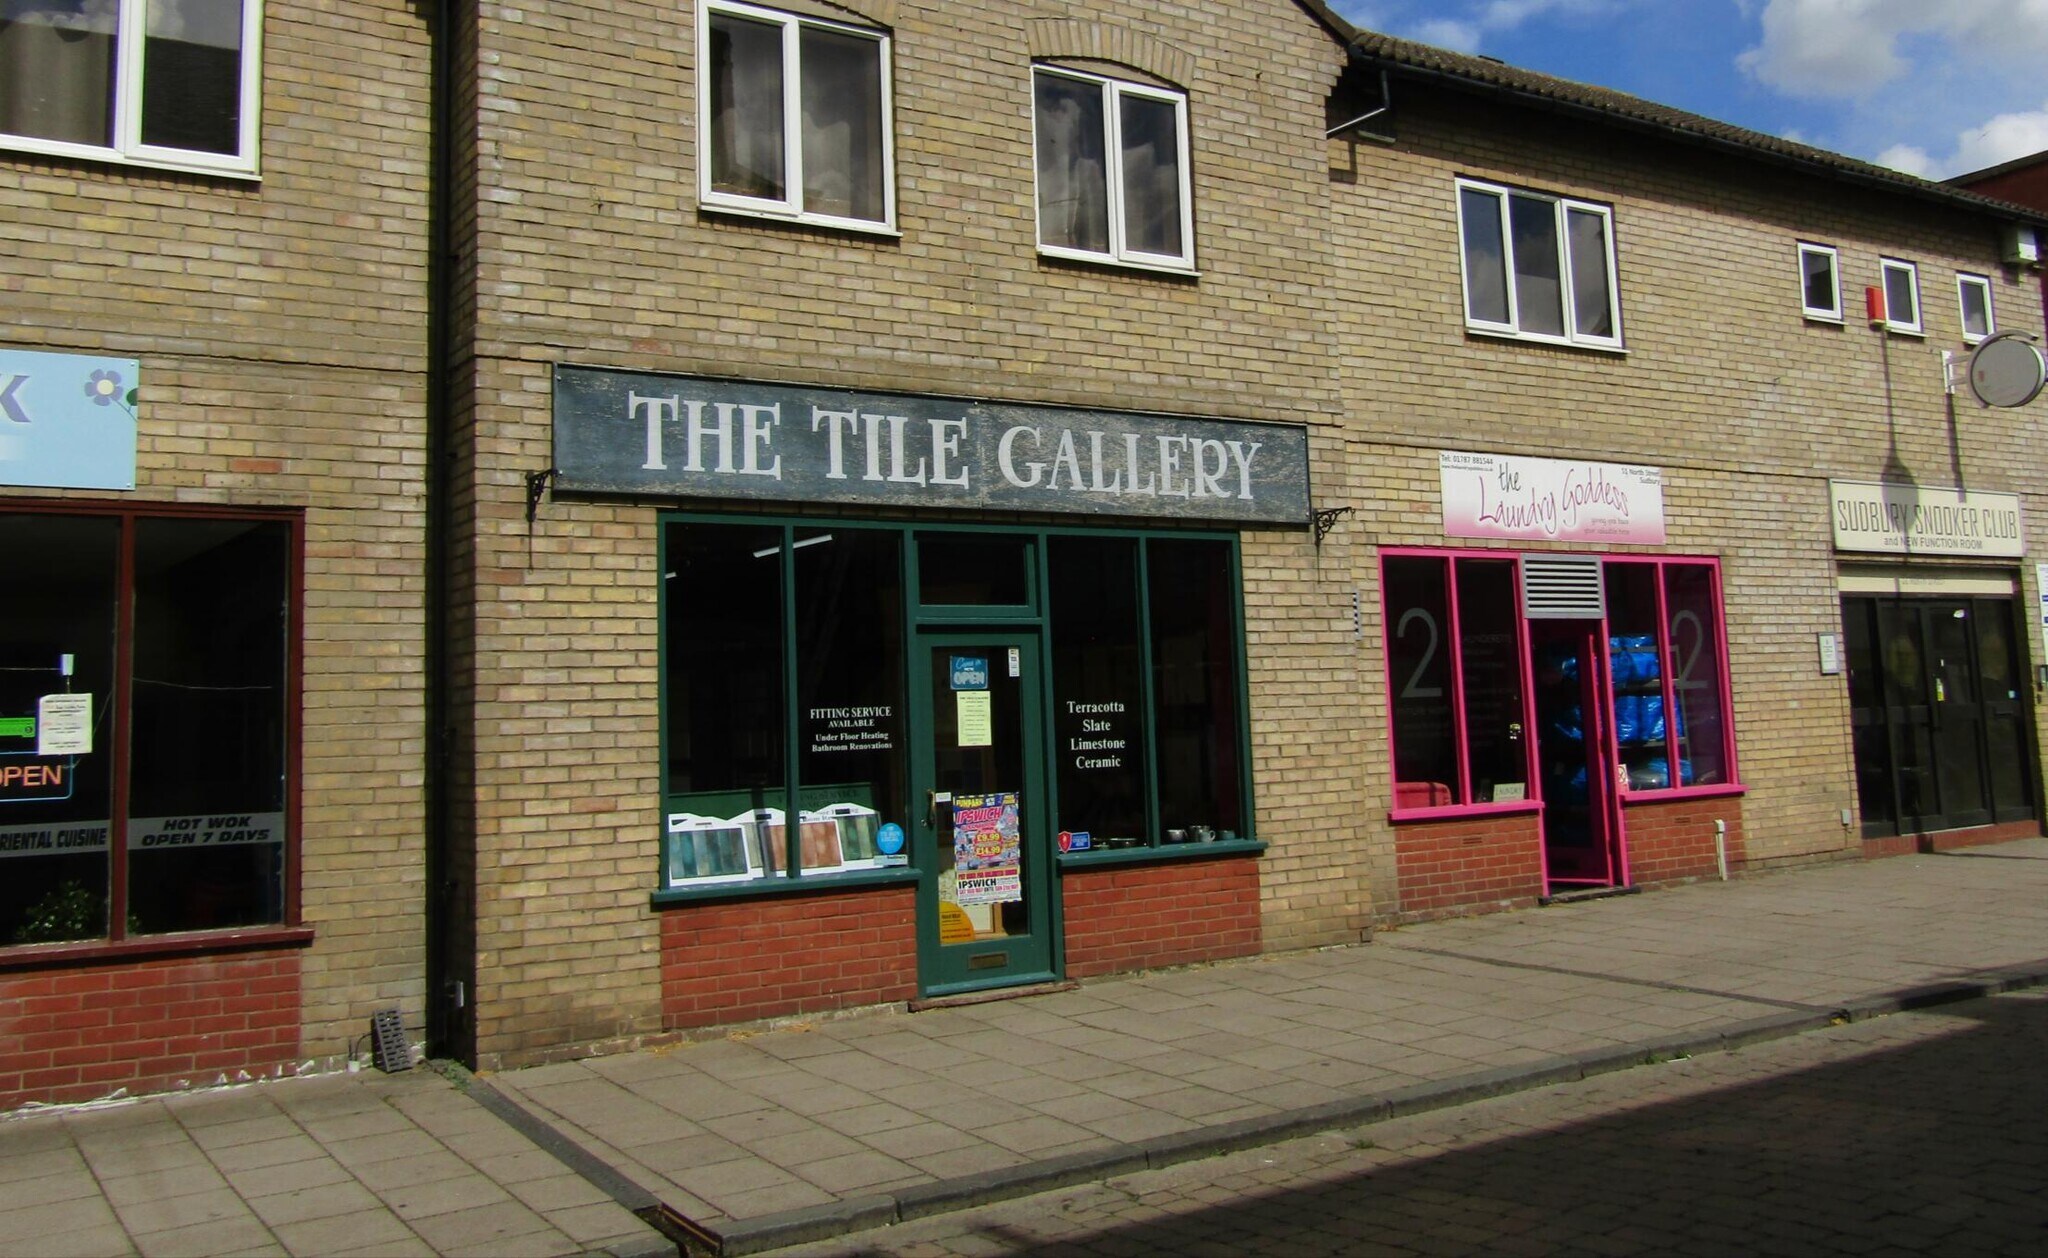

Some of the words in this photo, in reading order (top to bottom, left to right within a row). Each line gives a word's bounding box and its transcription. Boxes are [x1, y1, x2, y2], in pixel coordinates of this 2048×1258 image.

[628, 390, 781, 480] THE
[811, 405, 970, 489] TILE
[998, 425, 1262, 500] GALLERY
[1498, 461, 1522, 493] the
[1478, 474, 1557, 535] Laundry
[1562, 467, 1629, 528] Goddess
[1837, 500, 1907, 533] SUDBURY
[1914, 504, 1979, 537] SNOOKER
[1983, 509, 2018, 539] CLUB
[1884, 536, 1899, 547] and
[1900, 537, 1919, 547] NEW
[1920, 537, 1958, 549] FUNCTION
[1960, 538, 1984, 549] ROOM
[1397, 607, 1442, 698] 2
[1671, 609, 1709, 690] 2
[953, 671, 985, 685] OPEN
[810, 707, 850, 719] FITTING
[851, 706, 892, 718] SERVICE
[1066, 701, 1125, 713] Terracotta
[828, 719, 875, 728] AVAILABLE
[1082, 719, 1111, 732] Slate
[815, 733, 839, 742] Under
[840, 732, 859, 741] Floor
[861, 731, 889, 741] Heating
[812, 743, 848, 752] Bathroom
[849, 742, 893, 750] Renovations
[1070, 737, 1126, 751] Limestone
[1075, 755, 1121, 769] Ceramic
[0, 765, 62, 787] PEN
[956, 806, 1003, 824] IPSWICH
[163, 818, 202, 831] HOT
[207, 816, 252, 829] WOK
[0, 831, 53, 851] RIENTAL
[57, 828, 108, 848] CUISINE
[141, 833, 196, 846] OPEN
[202, 831, 214, 843] 7
[218, 829, 271, 842] DAYS
[958, 878, 997, 889] IPSWICH
